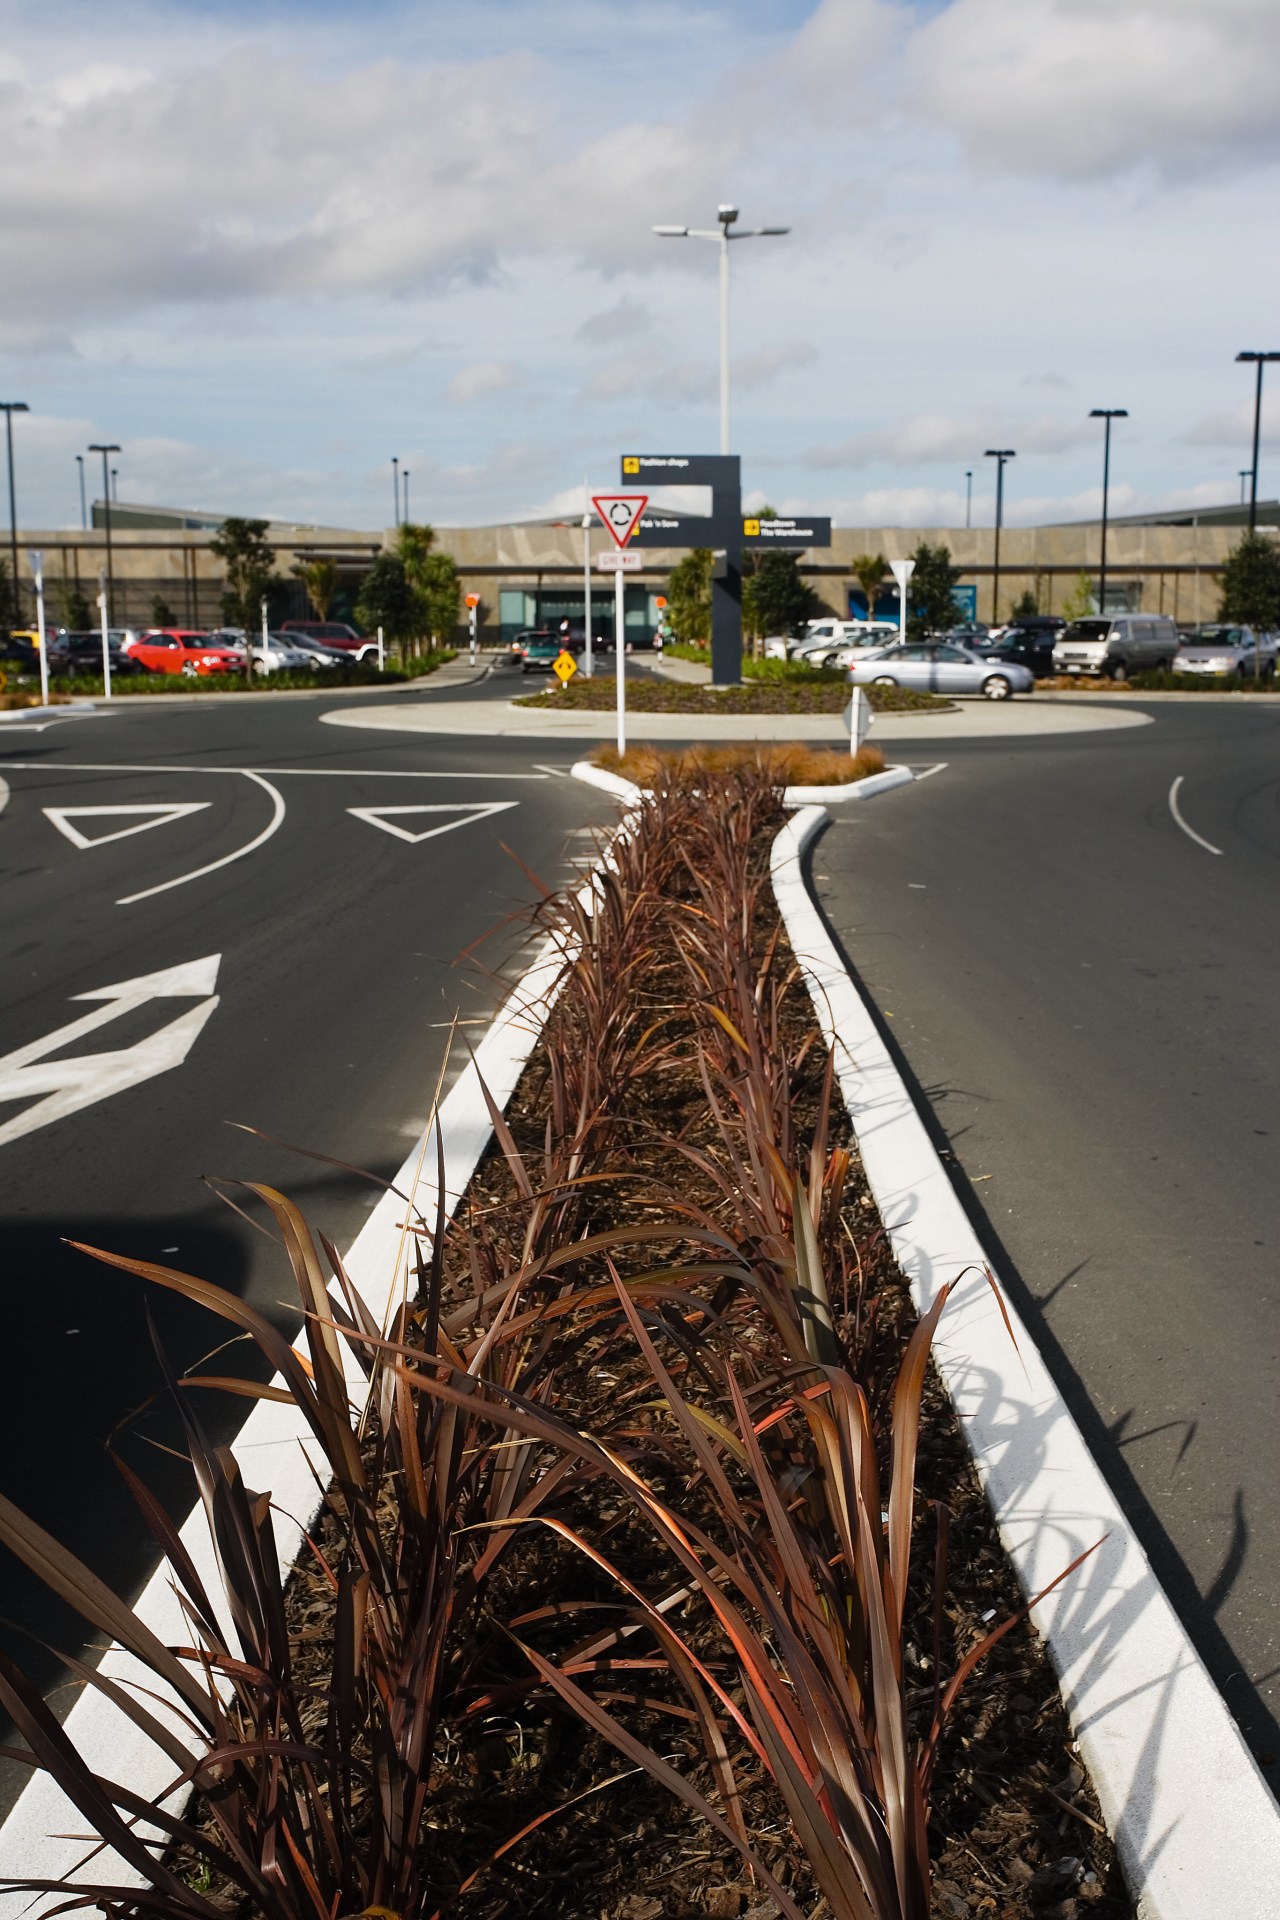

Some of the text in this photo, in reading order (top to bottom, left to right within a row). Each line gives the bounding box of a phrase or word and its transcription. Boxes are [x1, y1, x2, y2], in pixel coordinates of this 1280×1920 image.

[640, 457, 667, 467] Fashion
[760, 519, 796, 528] Foodtown
[760, 528, 814, 537] The Warehouse
